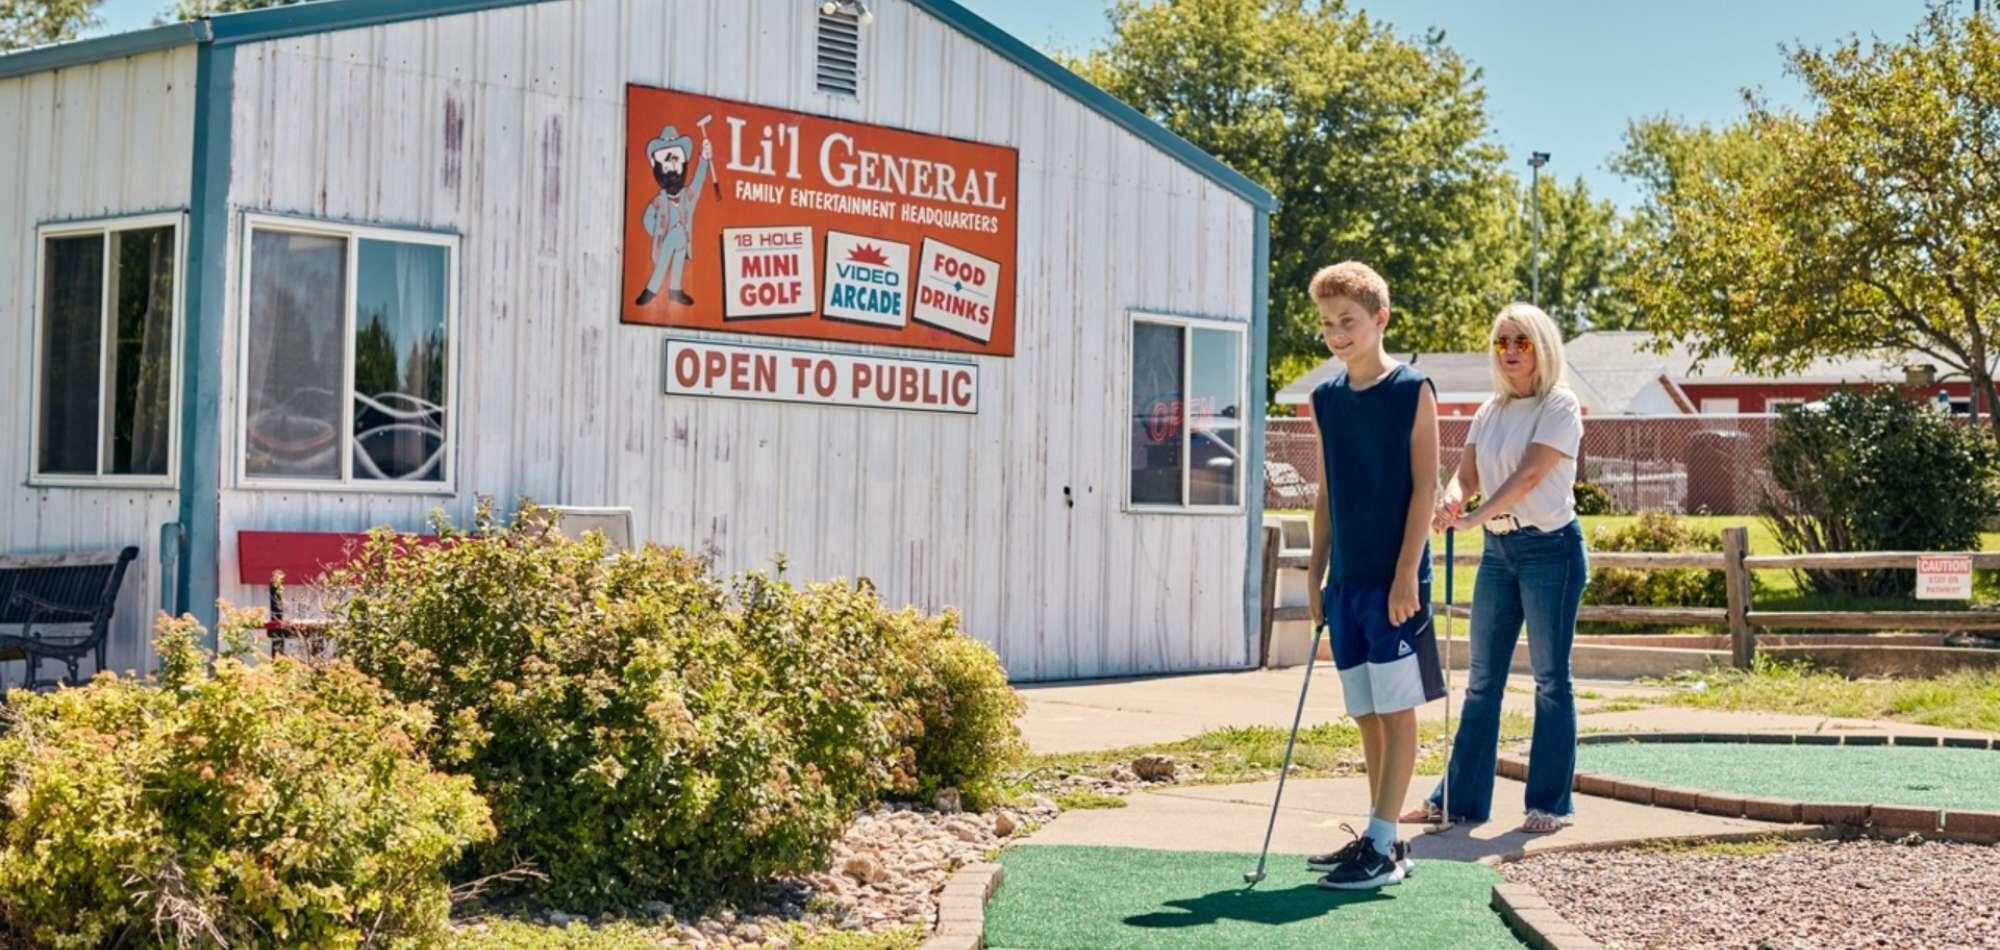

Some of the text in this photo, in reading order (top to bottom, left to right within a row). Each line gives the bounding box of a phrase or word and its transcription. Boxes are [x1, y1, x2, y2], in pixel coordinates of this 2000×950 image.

[726, 116, 1006, 210] Li'l GENERAL
[735, 180, 998, 234] FAMILY ENTERTAINMENT HEADQUARTERS
[734, 232, 804, 247] 18 HOLE
[741, 254, 799, 278] MINI
[836, 263, 900, 287] VIDEO
[933, 253, 986, 287] FOOD
[739, 281, 802, 306] GOLF
[830, 284, 901, 316] ARCADE
[919, 285, 990, 326] DRINKS
[675, 348, 972, 407] OPEN TO PUBLIC
[1921, 560, 1968, 573] CAUTION
